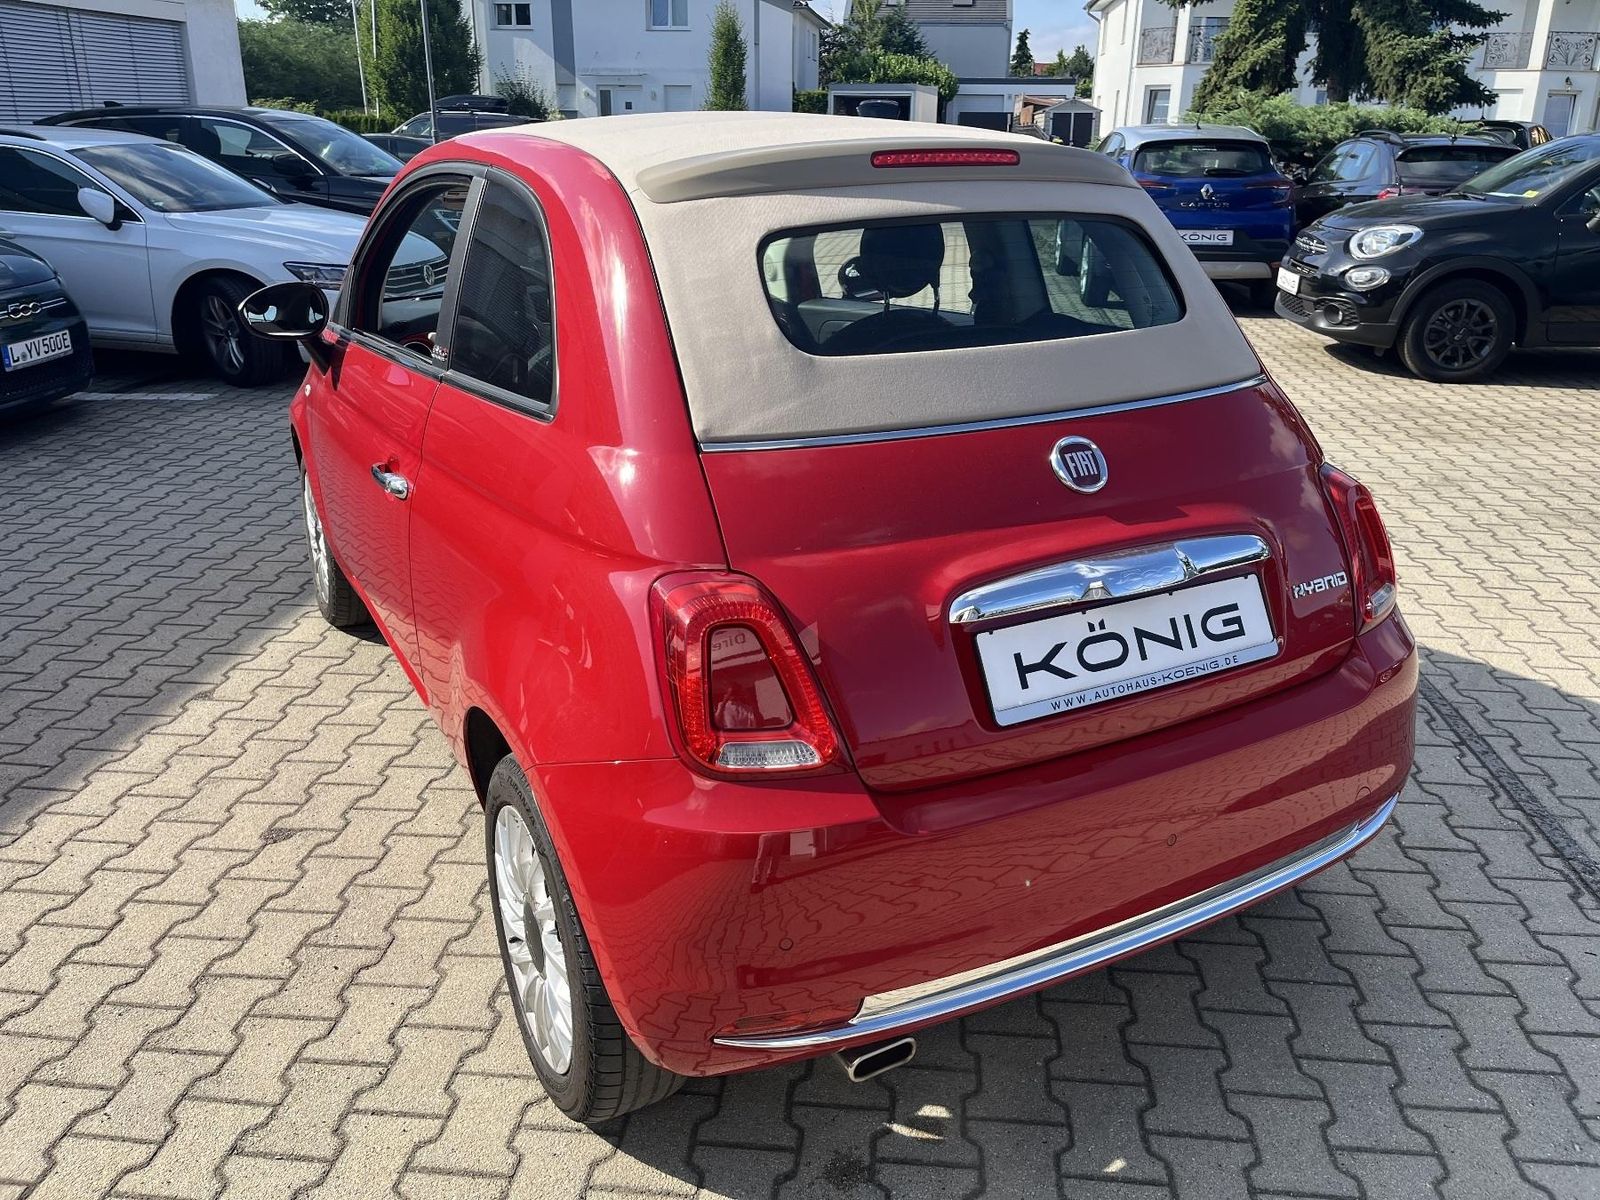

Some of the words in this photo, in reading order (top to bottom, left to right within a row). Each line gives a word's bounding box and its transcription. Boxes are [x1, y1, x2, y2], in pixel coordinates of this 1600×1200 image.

[8, 303, 41, 318] 500
[1064, 450, 1098, 478] FIAT
[1292, 571, 1348, 598] HYBRID
[1013, 602, 1247, 690] KÖNIG
[1050, 654, 1239, 711] WWW.AUTOHAUS-KOENIG.DE
